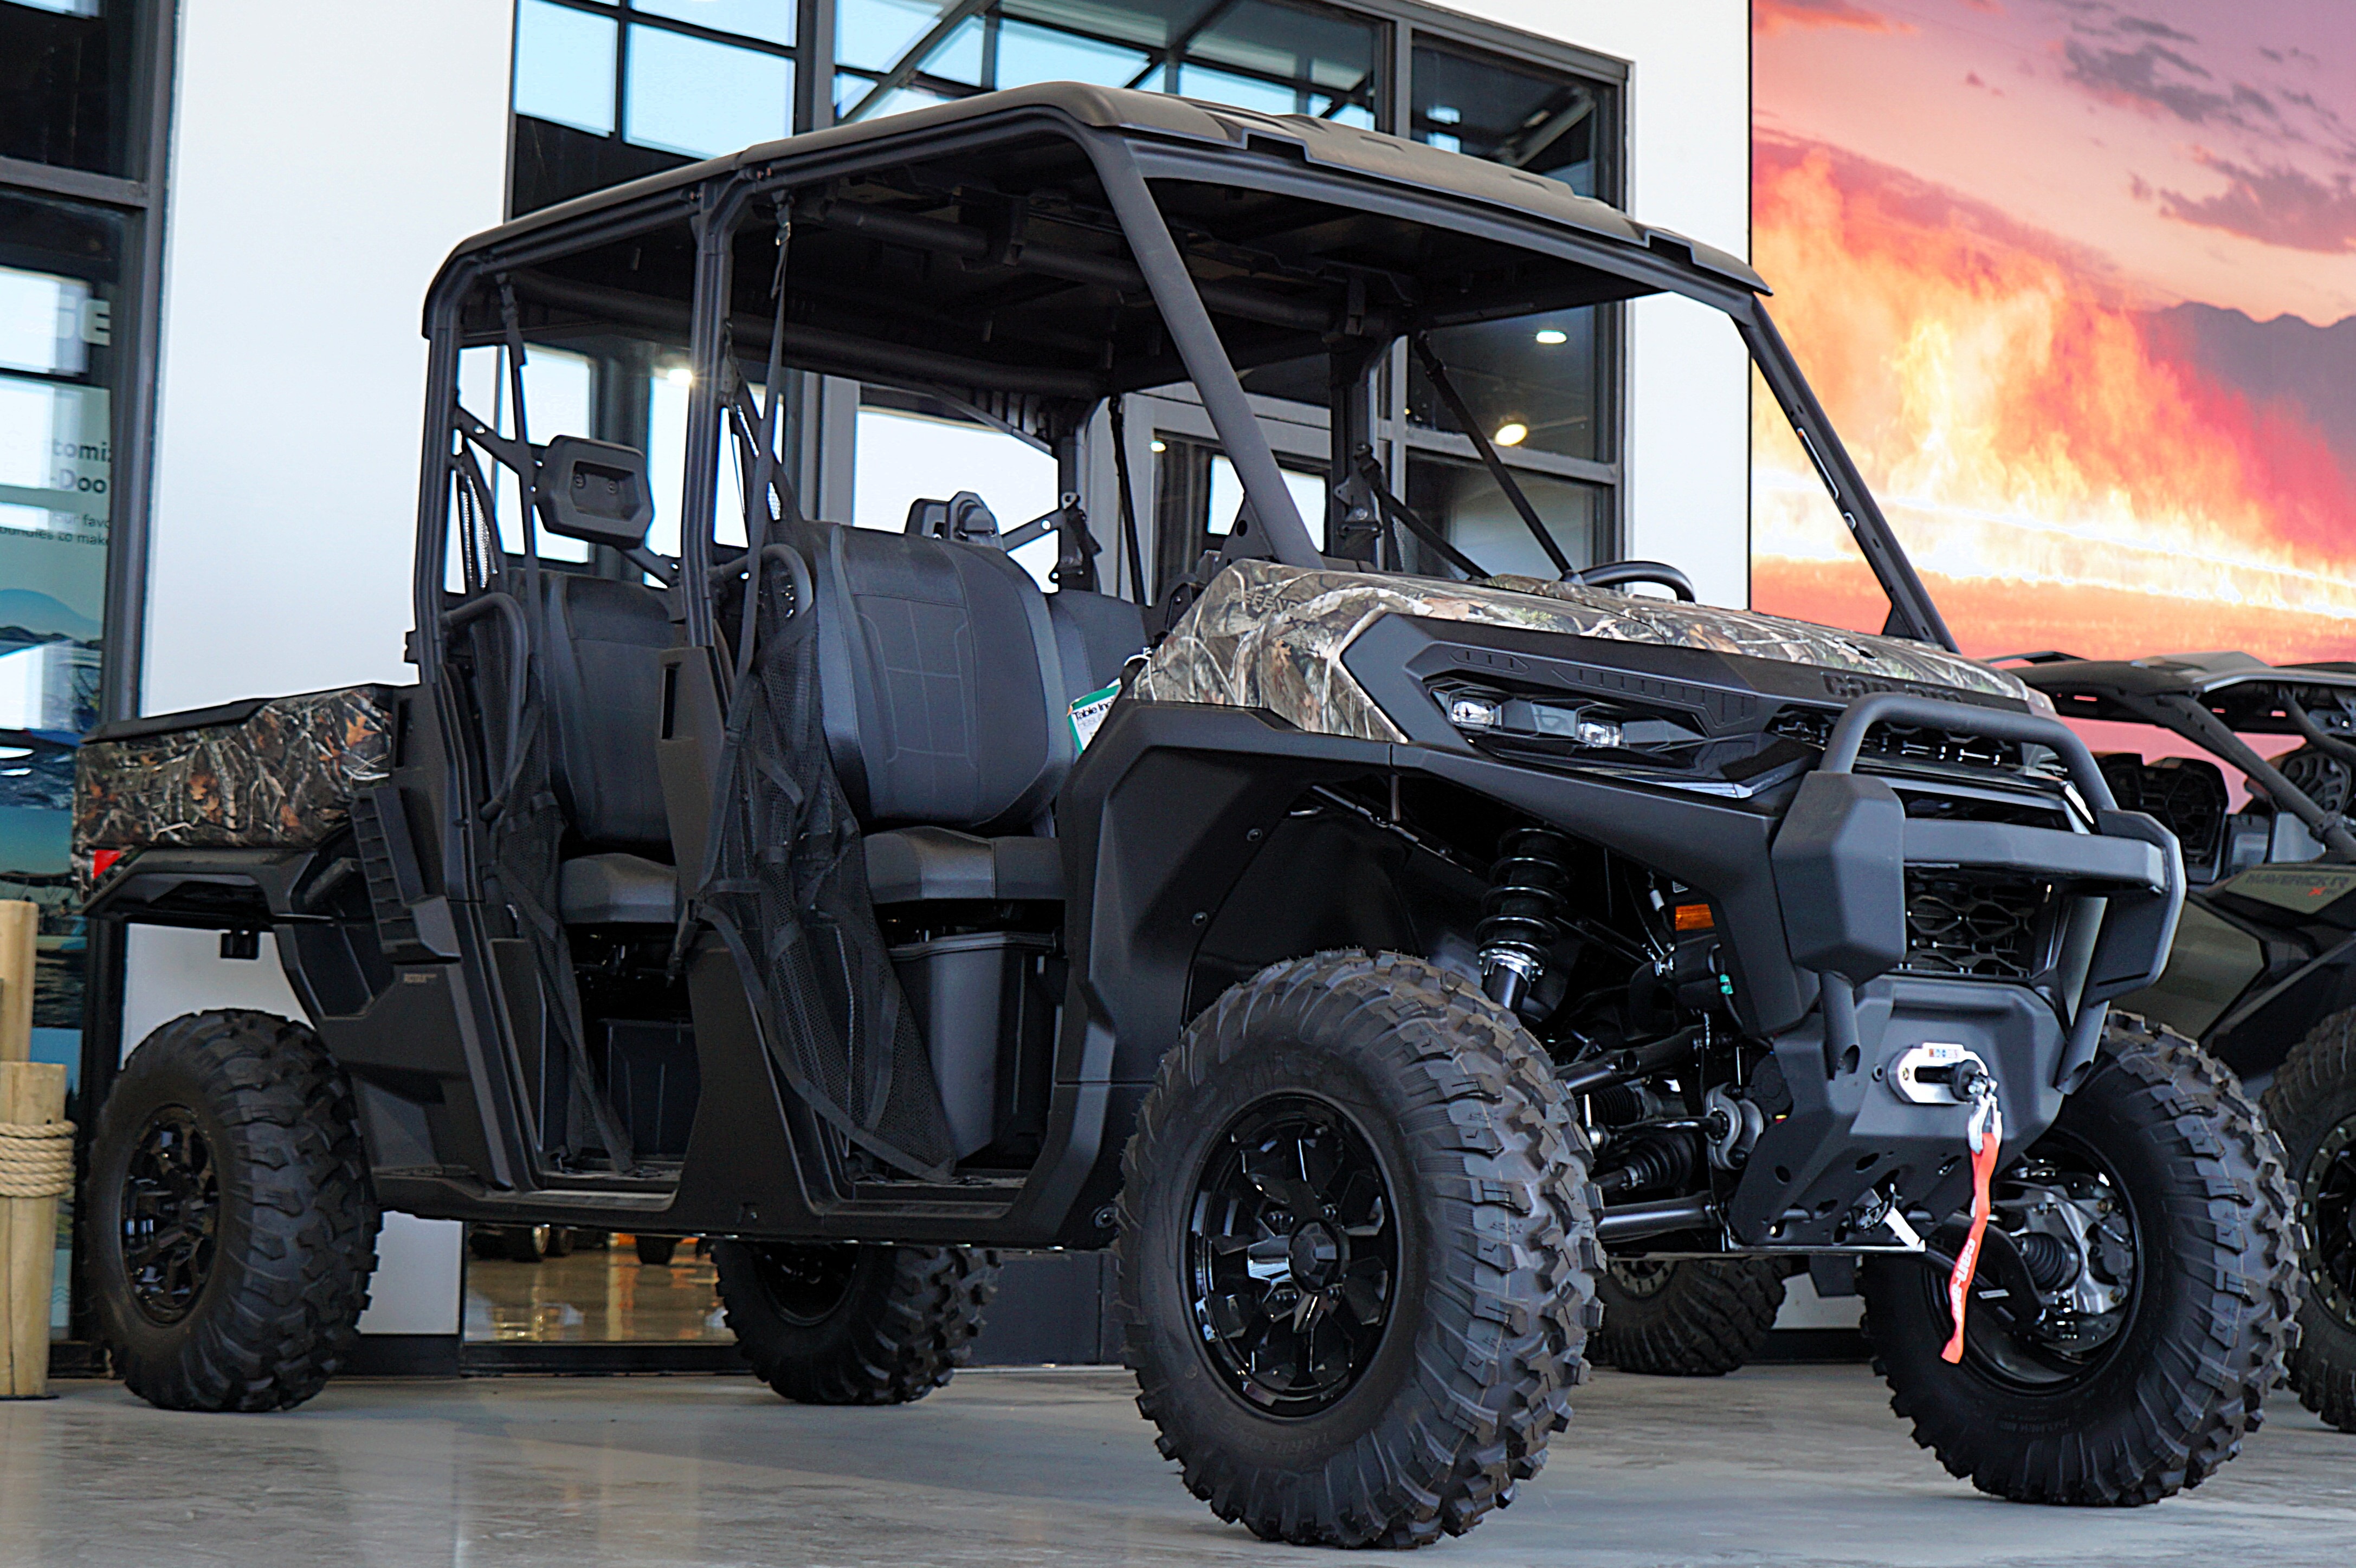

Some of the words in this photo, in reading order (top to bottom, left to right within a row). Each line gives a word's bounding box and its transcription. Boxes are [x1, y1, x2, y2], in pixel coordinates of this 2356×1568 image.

[53, 439, 111, 462] tomi
[78, 533, 108, 546] mak
[1073, 707, 1097, 720] Table
